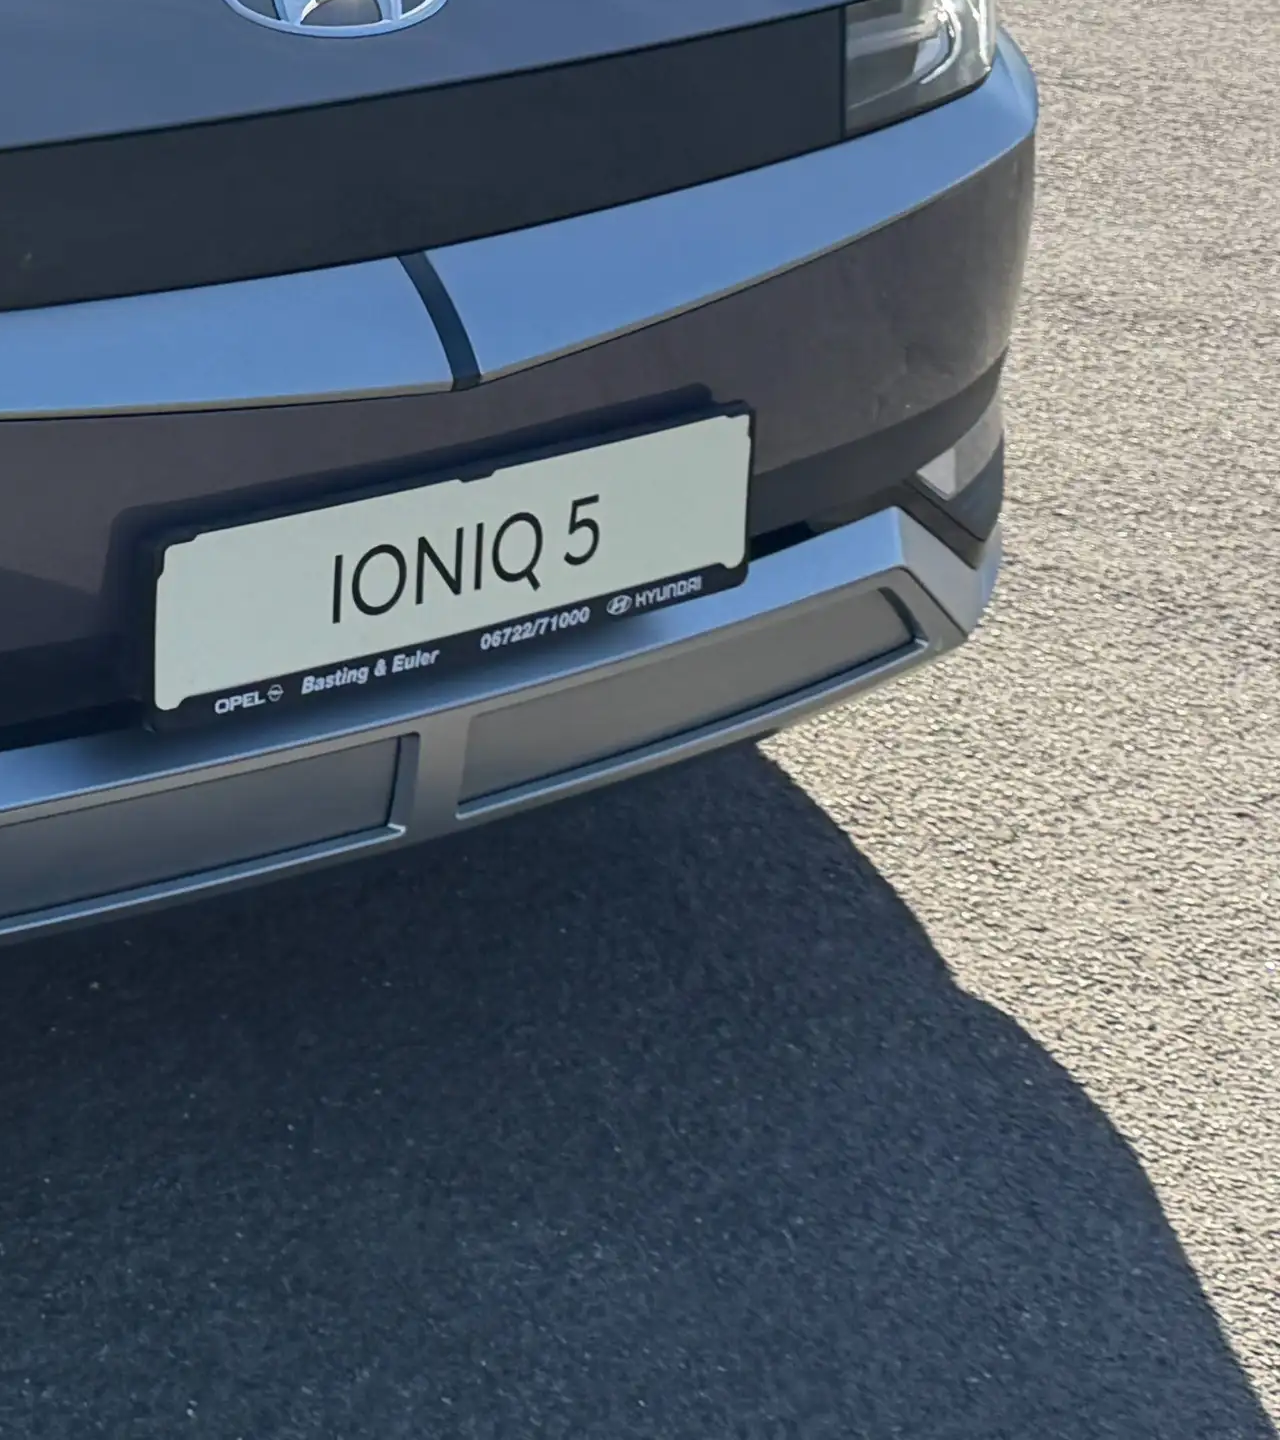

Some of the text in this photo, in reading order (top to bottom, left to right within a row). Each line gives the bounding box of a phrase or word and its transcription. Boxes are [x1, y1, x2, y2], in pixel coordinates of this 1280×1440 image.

[332, 494, 600, 624] IONIQ 5
[214, 576, 703, 714] OPEL Basting & Euler 06722/71000 HYUNDAI
